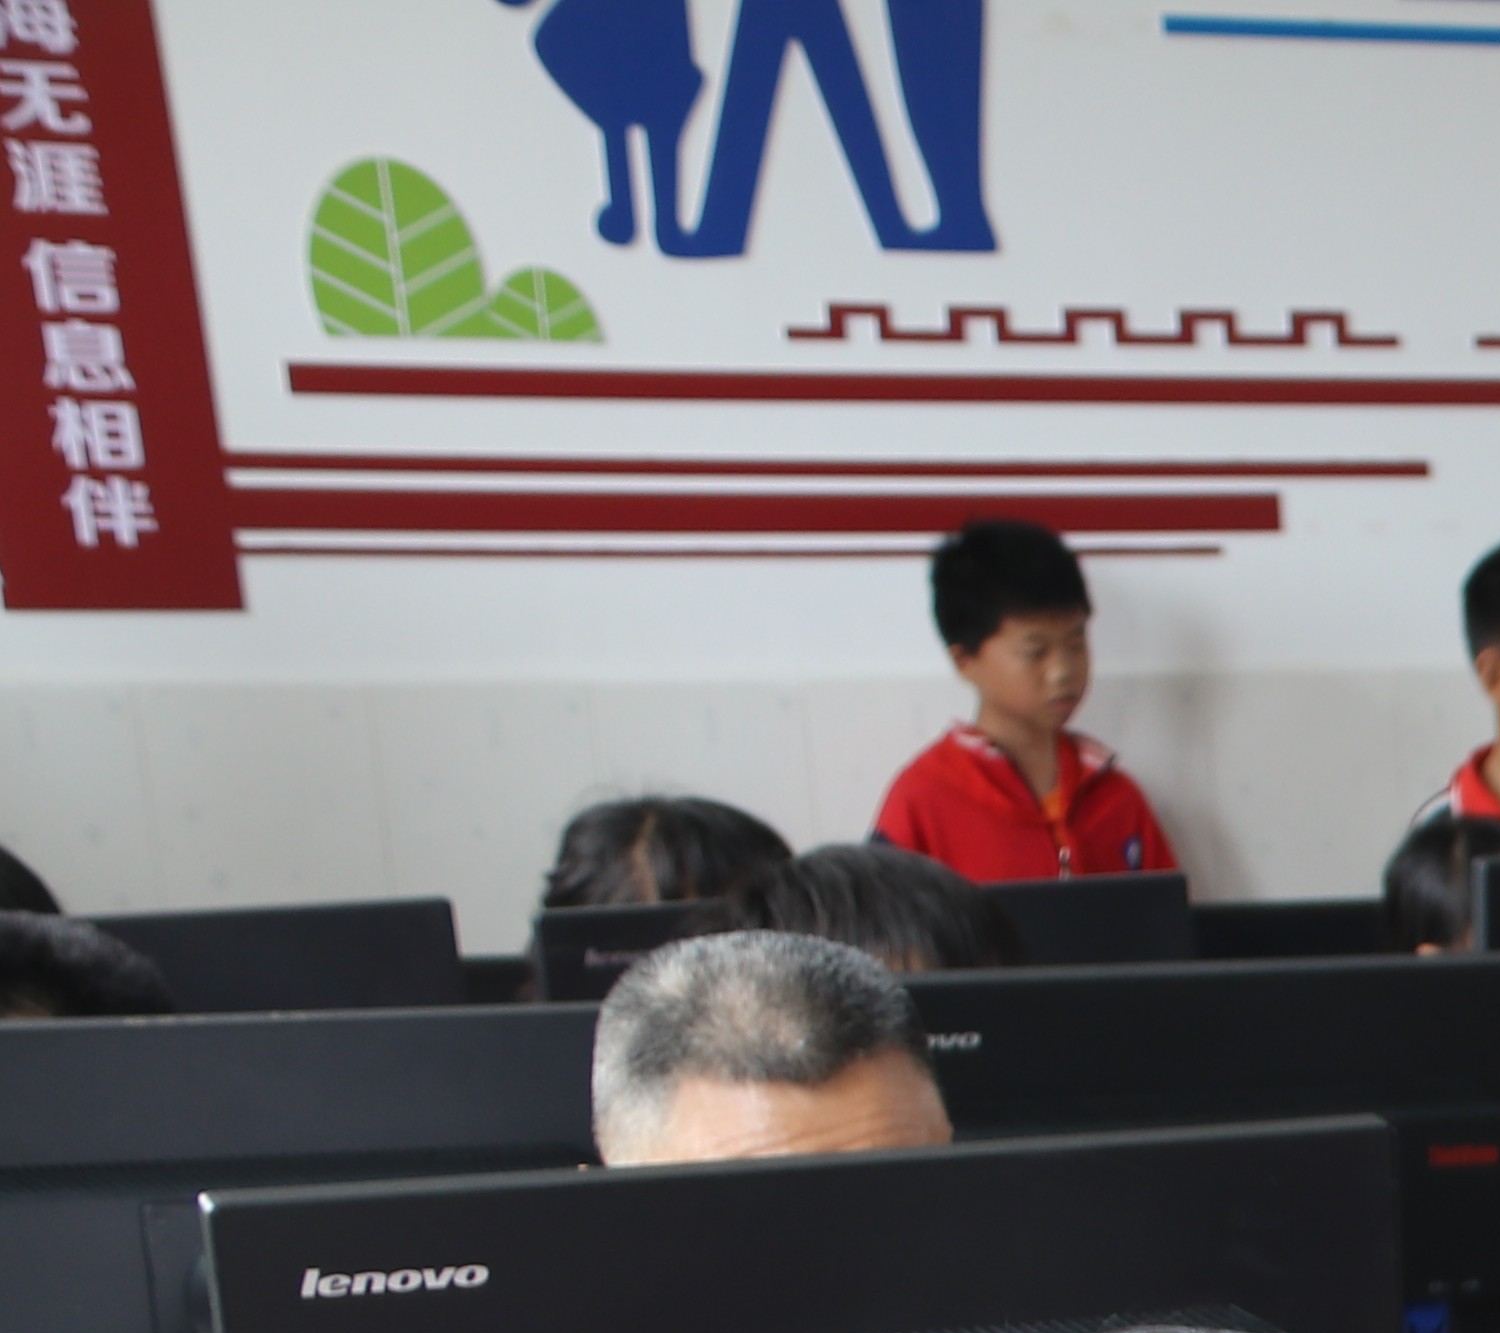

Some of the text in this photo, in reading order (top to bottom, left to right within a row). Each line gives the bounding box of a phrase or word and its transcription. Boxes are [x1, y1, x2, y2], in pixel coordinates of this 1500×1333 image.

[21, 236, 159, 549] 信息相伴
[300, 1263, 490, 1300] lenovo
